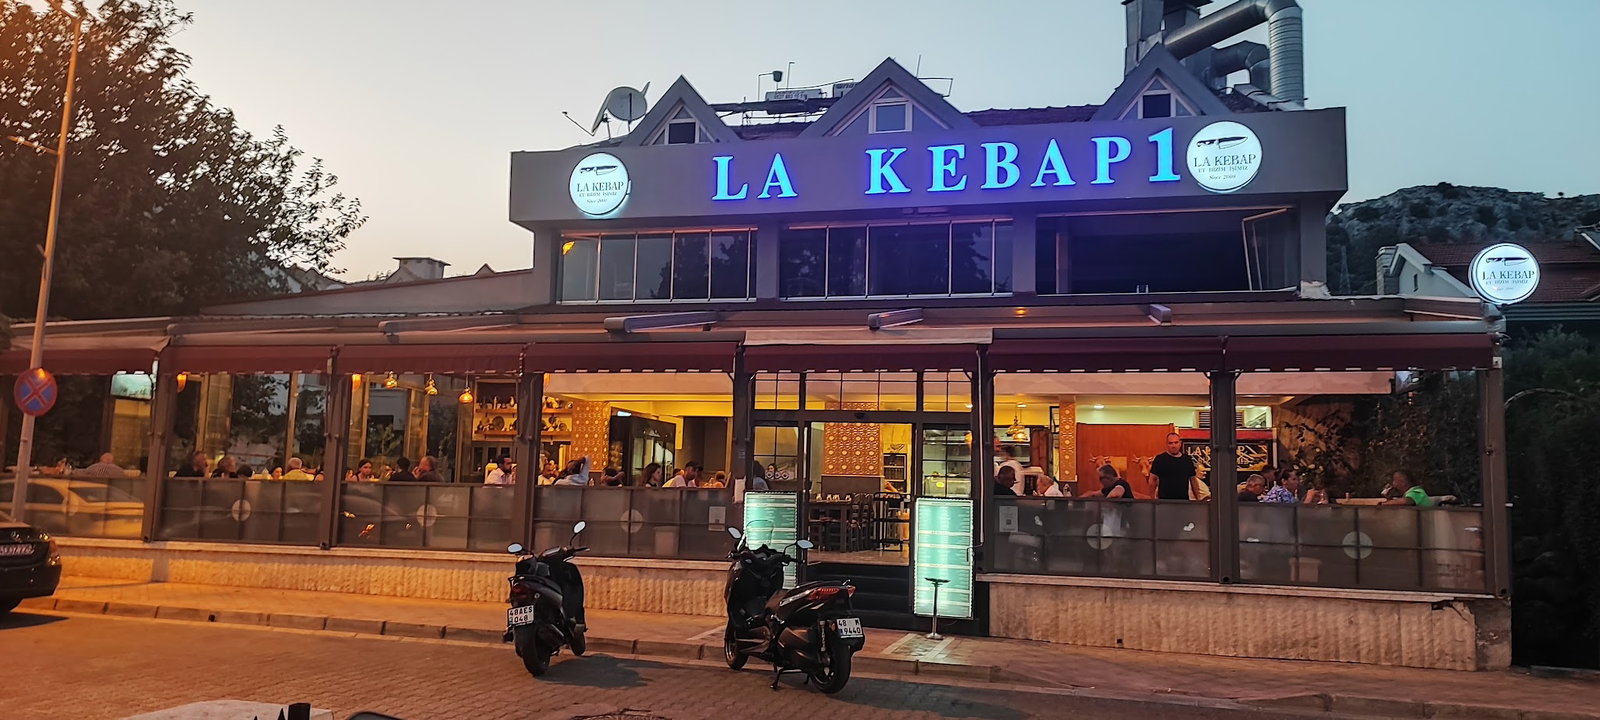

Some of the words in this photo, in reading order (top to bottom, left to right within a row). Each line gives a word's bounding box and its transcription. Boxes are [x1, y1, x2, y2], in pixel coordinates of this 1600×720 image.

[1194, 156, 1211, 168] LA
[1214, 154, 1256, 166] KEBAP
[711, 152, 799, 201] LA
[577, 182, 590, 192] LA
[592, 181, 624, 192] KEBAP
[1482, 271, 1496, 281] LA
[1500, 270, 1535, 280] KEBAP
[838, 619, 847, 627] 48
